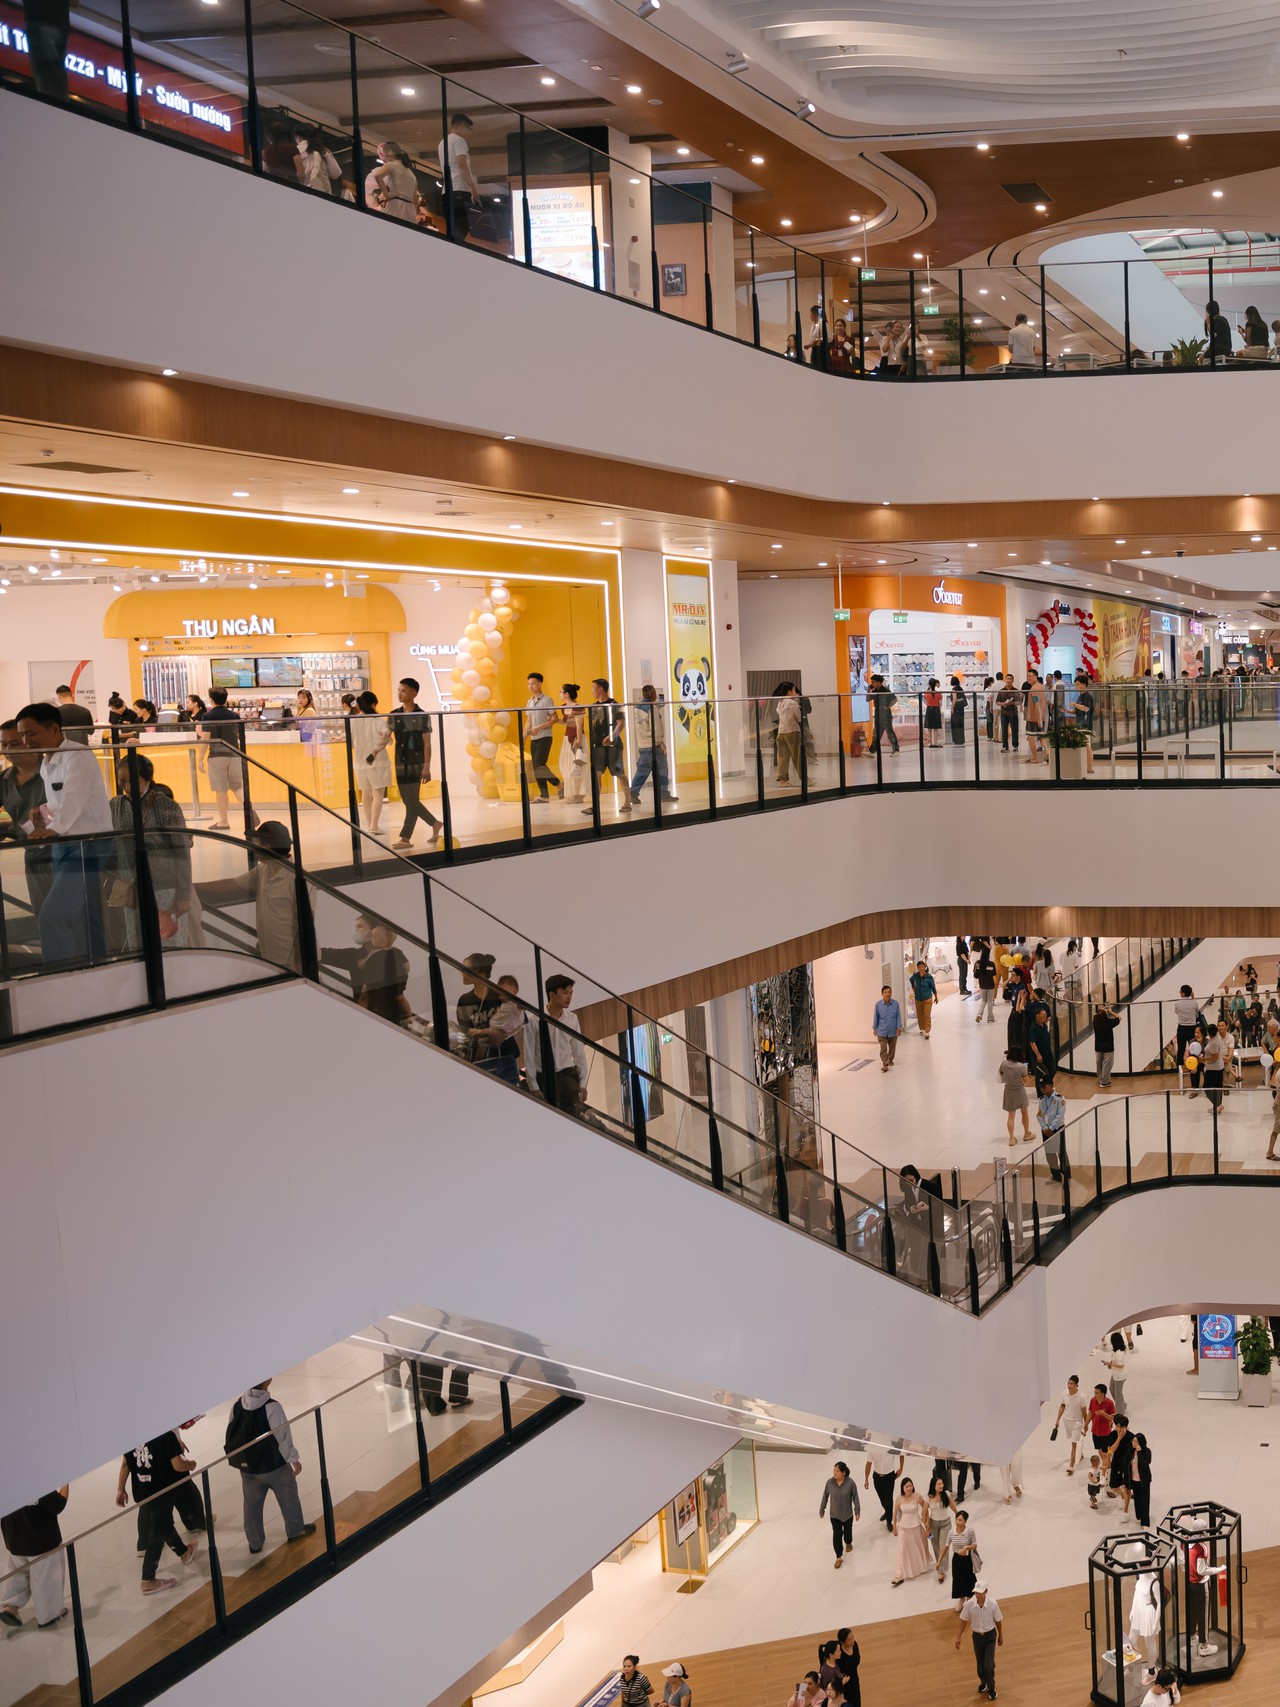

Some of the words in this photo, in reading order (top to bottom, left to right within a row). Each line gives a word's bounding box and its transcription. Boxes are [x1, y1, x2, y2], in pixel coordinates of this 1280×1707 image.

[65, 53, 95, 78] zza
[182, 619, 218, 637] THU
[222, 614, 275, 636] NGÂN
[410, 643, 437, 656] CÙNG
